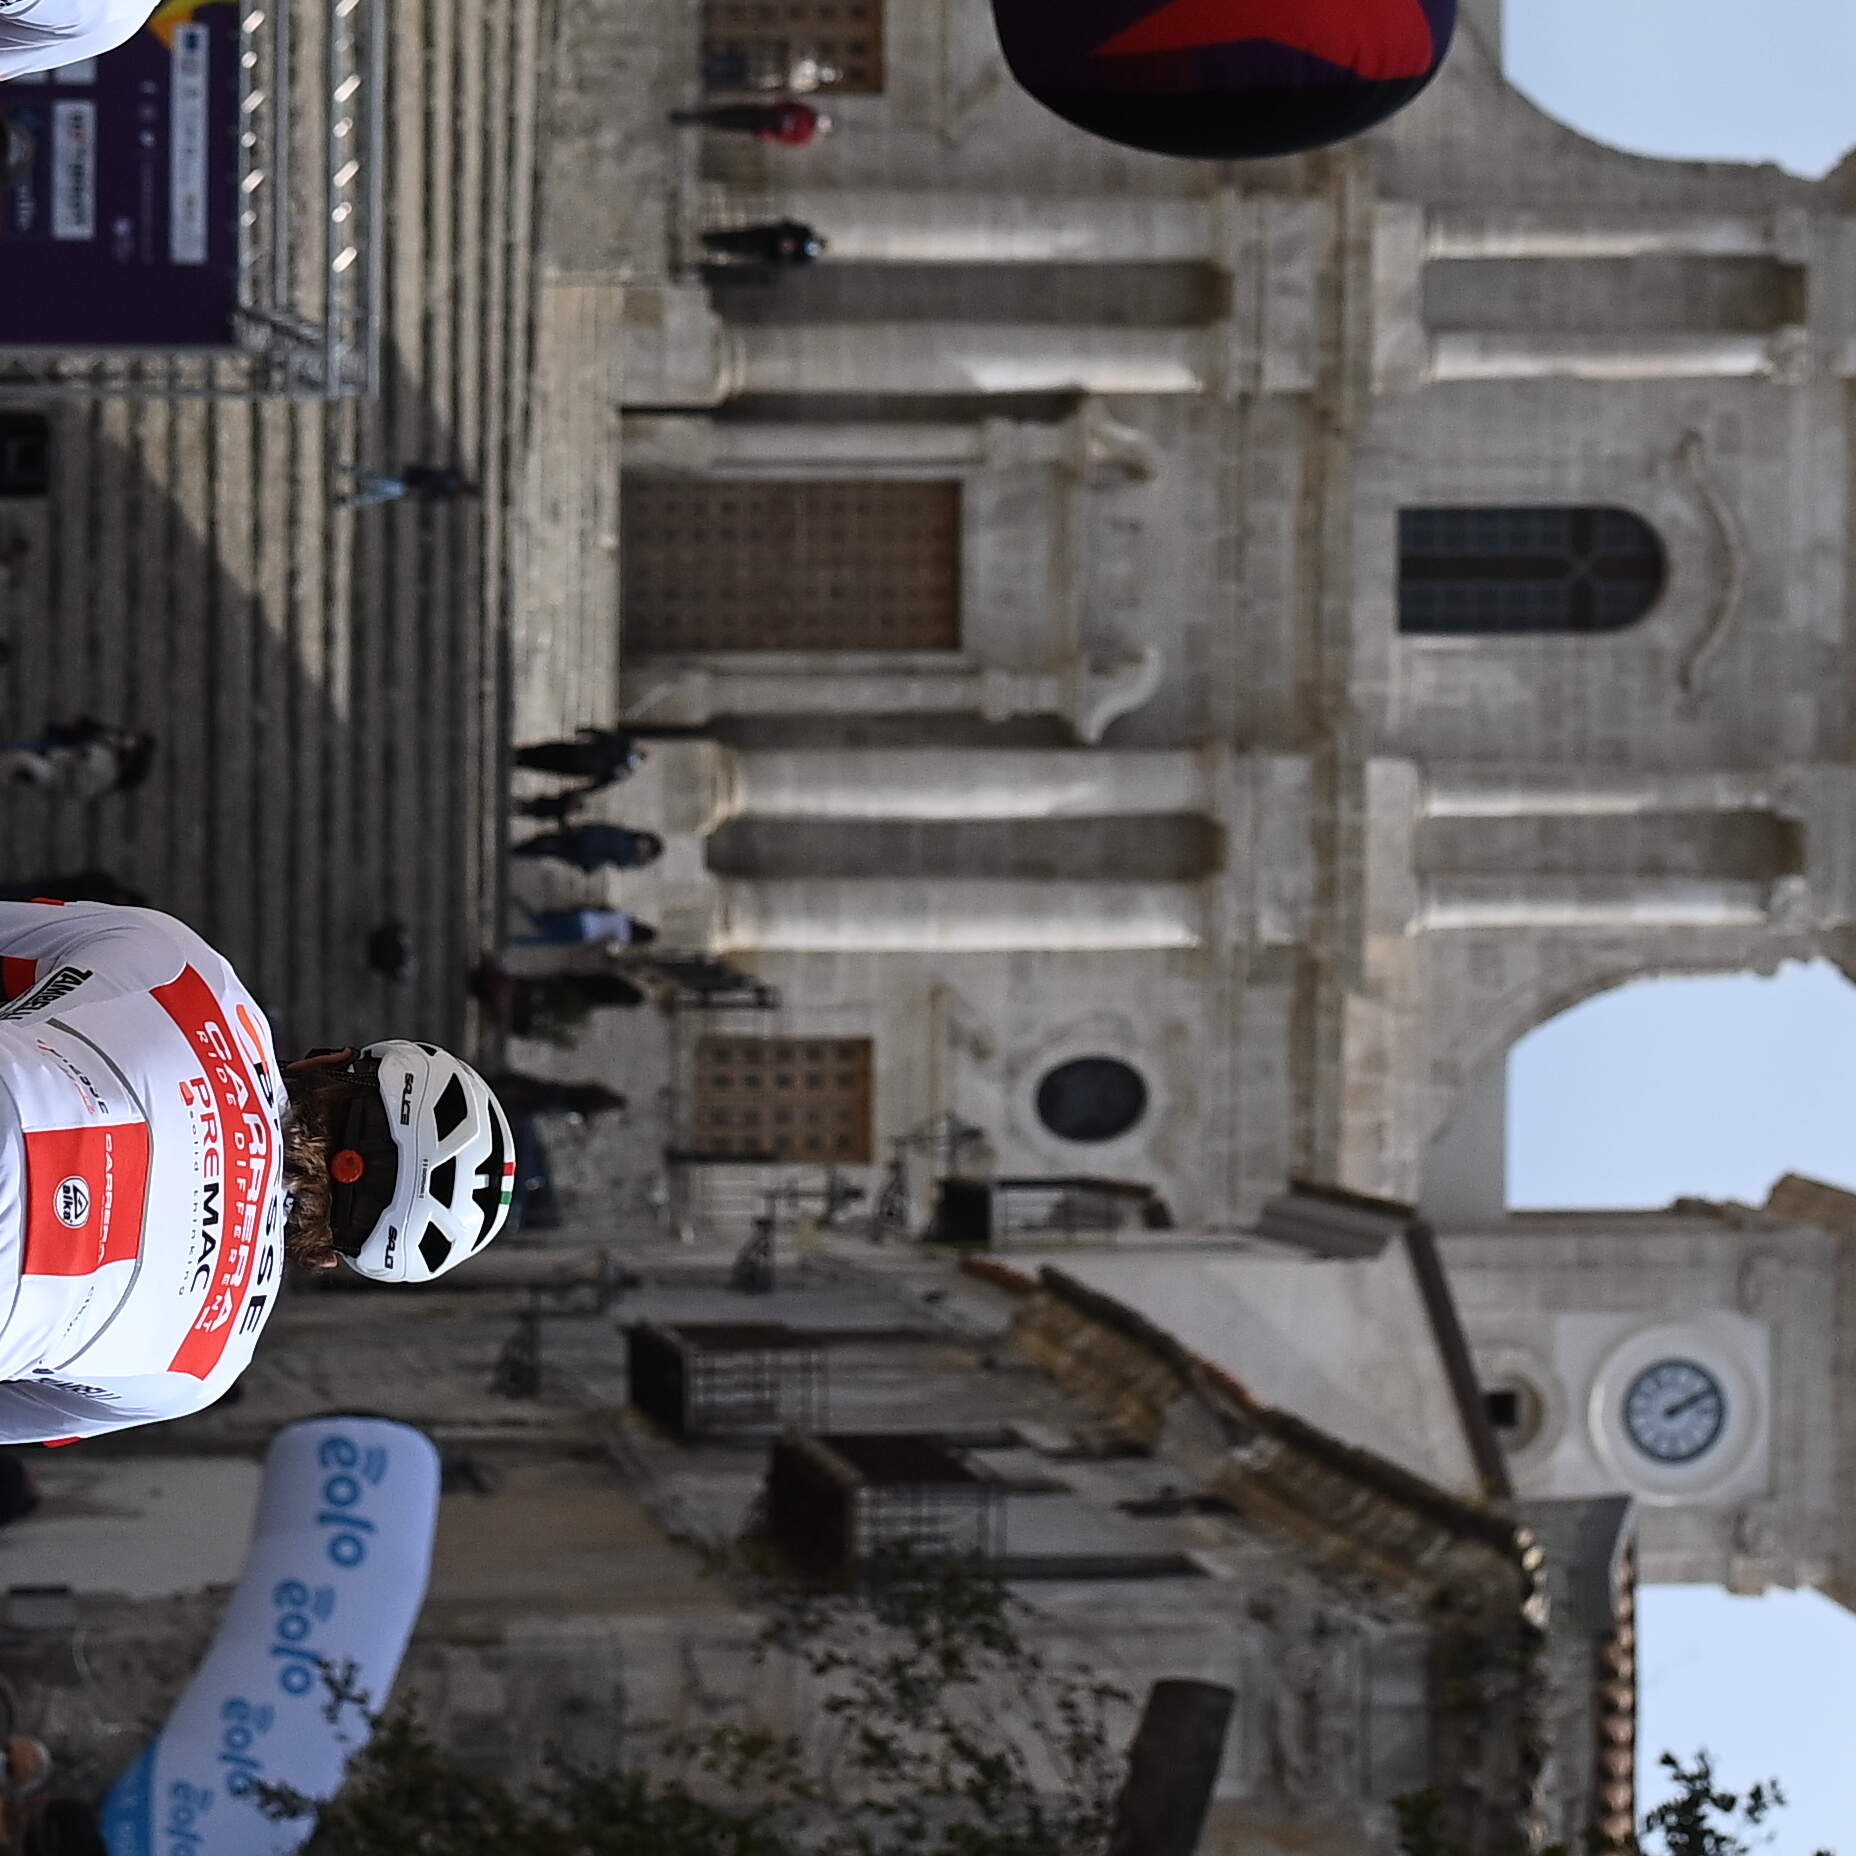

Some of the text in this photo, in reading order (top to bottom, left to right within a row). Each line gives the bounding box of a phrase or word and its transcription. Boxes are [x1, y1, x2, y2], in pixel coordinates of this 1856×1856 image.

[178, 1109, 201, 1297] solid thinking
[190, 1076, 221, 1294] PREMAC
[196, 1030, 247, 1334] RIDE DIFFERENT
[202, 1020, 269, 1332] CARRERA
[317, 1436, 379, 1568] eolo
[270, 1580, 324, 1697] eolo
